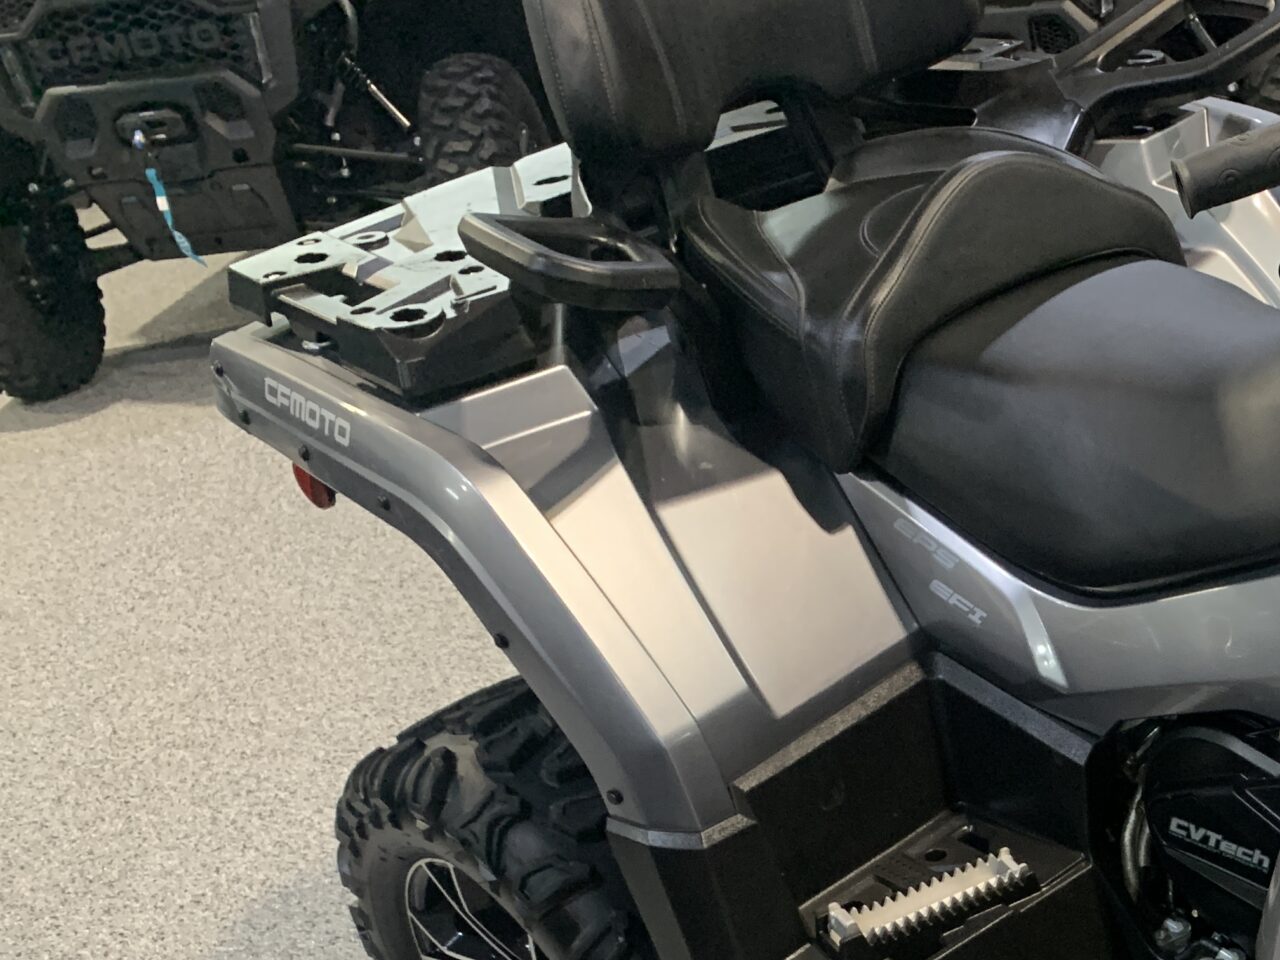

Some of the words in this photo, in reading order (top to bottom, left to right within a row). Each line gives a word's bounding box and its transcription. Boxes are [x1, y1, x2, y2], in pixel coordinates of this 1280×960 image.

[37, 20, 221, 67] CFMOTO
[264, 377, 351, 447] CFMOTO
[894, 518, 960, 570] EPS
[929, 579, 988, 626] EFI
[1169, 816, 1270, 869] CVTech
